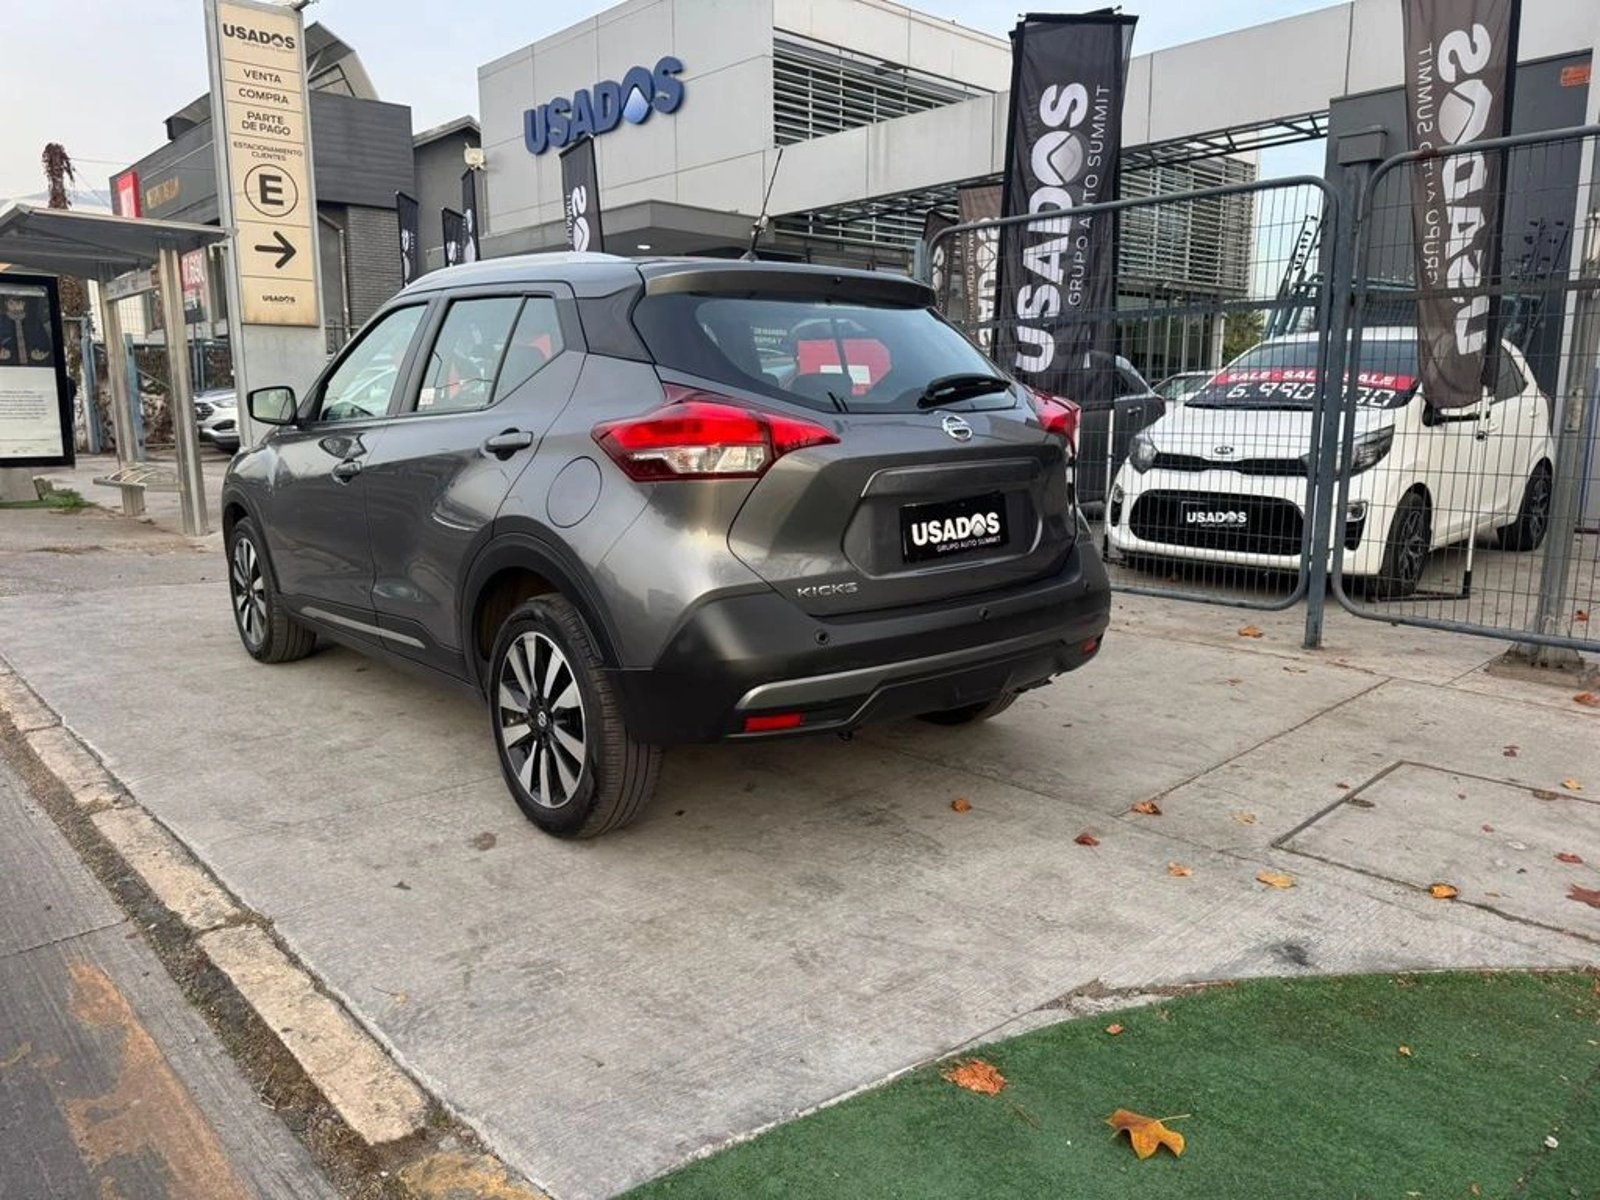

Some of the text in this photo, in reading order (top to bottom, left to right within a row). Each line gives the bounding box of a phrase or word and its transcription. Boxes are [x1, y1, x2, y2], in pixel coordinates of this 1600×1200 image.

[222, 23, 296, 50] USADOS
[243, 68, 282, 84] VENTA
[238, 88, 289, 104] COMPRA
[523, 56, 685, 155] USADOS
[246, 110, 284, 125] PARTE
[241, 120, 291, 136] DE PAGO
[251, 151, 287, 161] CLIENTES
[258, 173, 284, 206] E
[1068, 234, 1090, 307] GRUPO
[1086, 84, 1111, 169] SUMMIT
[1014, 82, 1089, 374] USADOS
[262, 294, 296, 303] USADOS
[1228, 370, 1395, 386] SALE SAL ALE
[1186, 511, 1247, 523] USADOS
[911, 511, 1001, 546] USADOS
[797, 582, 859, 597] KICKS
